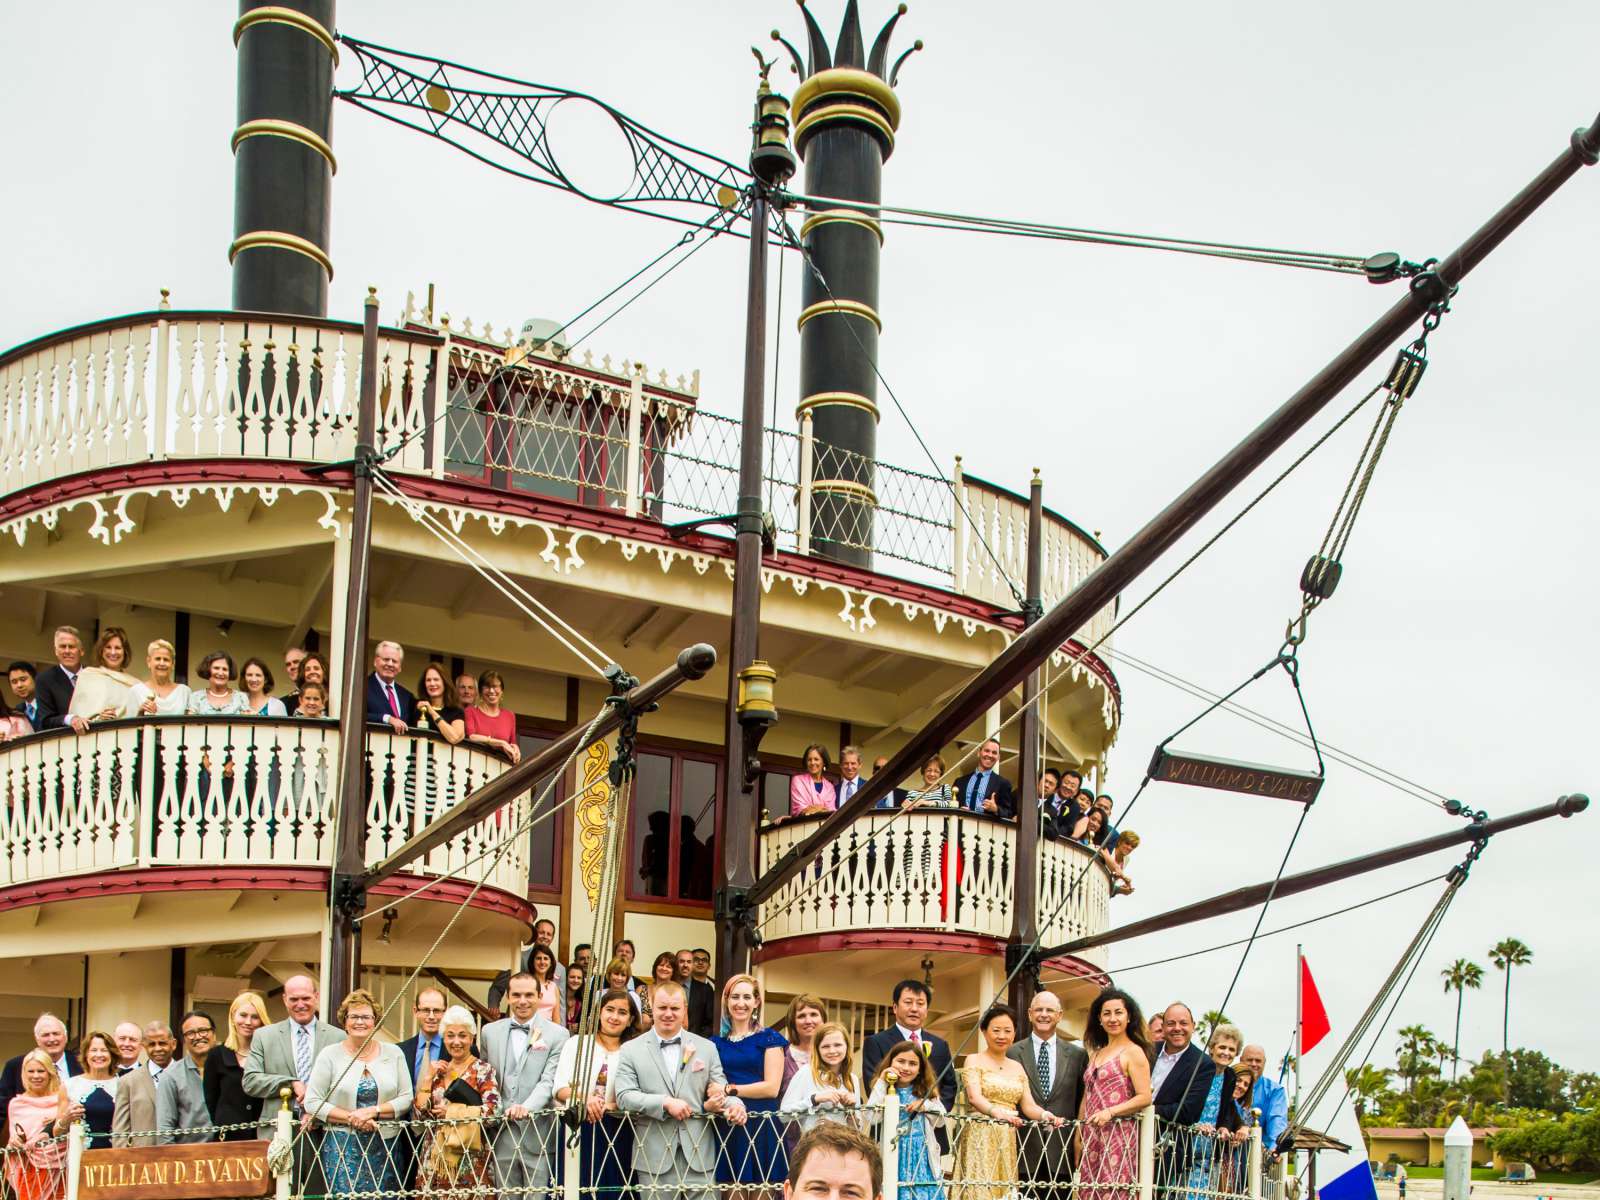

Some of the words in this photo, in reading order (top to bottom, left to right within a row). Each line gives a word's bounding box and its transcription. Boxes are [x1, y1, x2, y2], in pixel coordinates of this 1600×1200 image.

[1168, 761, 1242, 786] WILLIAM
[1258, 777, 1313, 799] EVANS
[84, 1162, 168, 1187] WILLIAM
[174, 1160, 189, 1184] D.
[193, 1157, 265, 1184] EVANS
